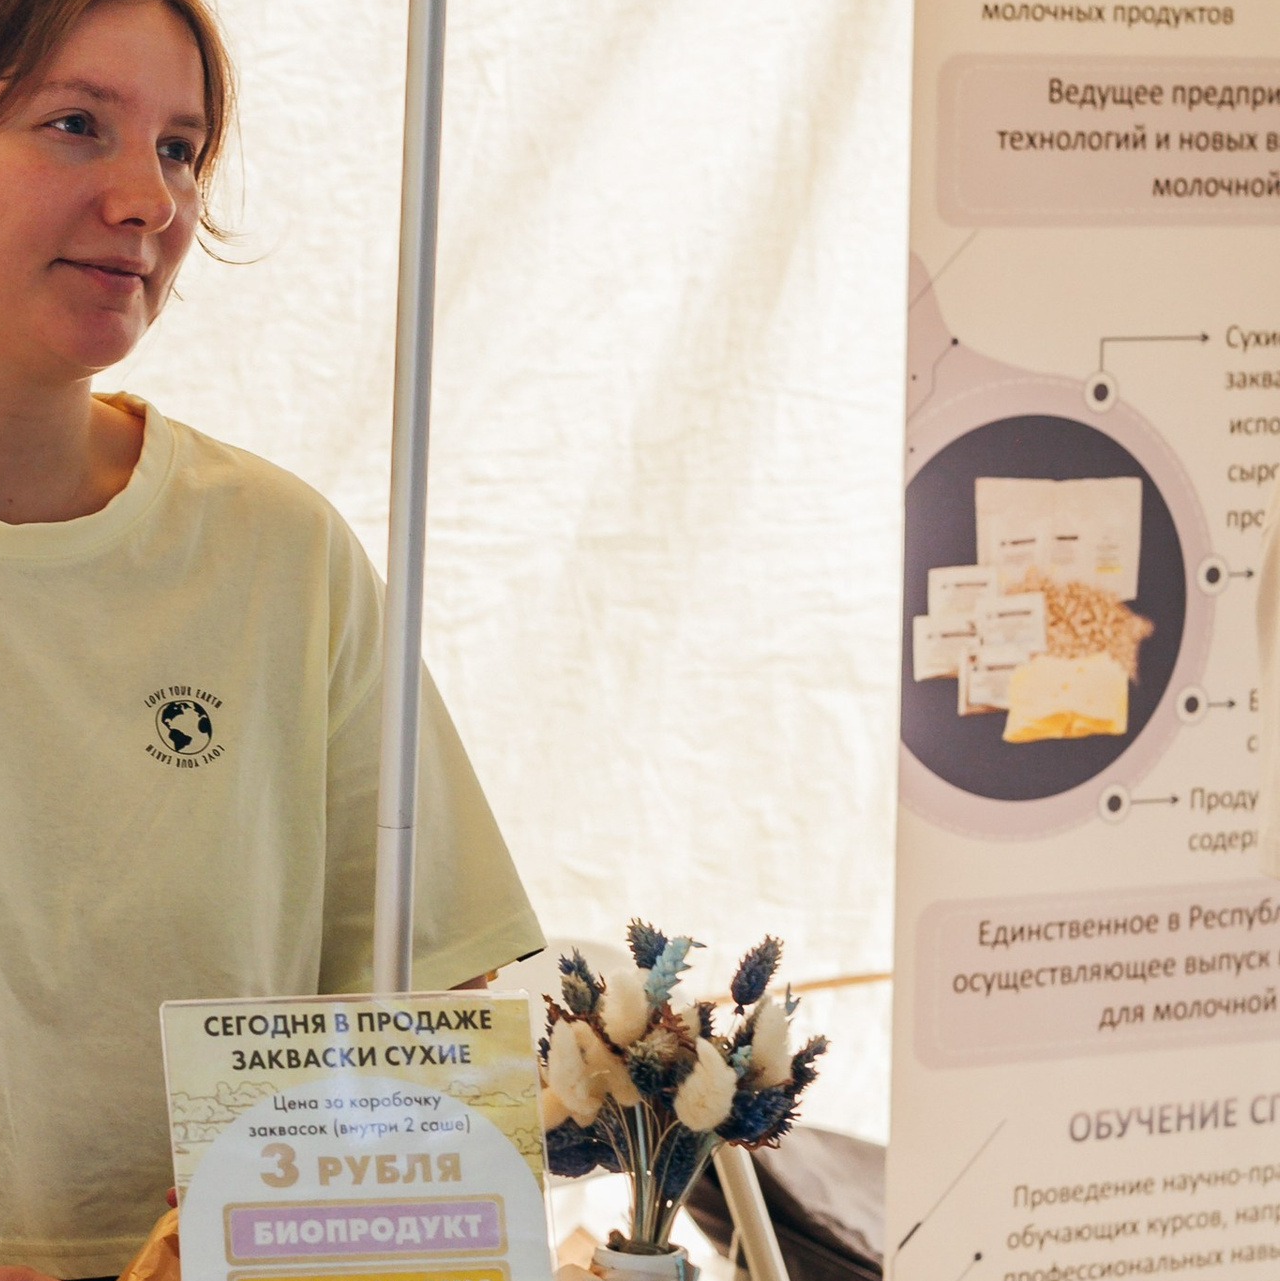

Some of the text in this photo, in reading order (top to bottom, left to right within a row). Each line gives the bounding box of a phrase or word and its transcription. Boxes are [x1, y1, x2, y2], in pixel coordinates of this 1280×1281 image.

[981, 2, 1235, 29] молочных продуктов
[1048, 77, 1164, 111] Ведущее
[997, 124, 1259, 153] технологий и новых
[144, 688, 167, 709] LOVE
[1187, 829, 1259, 856] содер
[978, 914, 1160, 951] Единственное
[1167, 912, 1181, 933] в
[952, 949, 1271, 997] осуществляющее выпуск
[204, 1009, 493, 1039] СЕГОДНЯ В ПРОДАЖЕ
[1098, 985, 1278, 1031] для молочной
[231, 1044, 472, 1071] ЗАКВАСКИ СУХИЕ
[273, 1090, 442, 1113] Цена за коробочку
[248, 1114, 471, 1139] заквасок (внутри 2 саше)
[1069, 1097, 1239, 1143] ОБУЧЕНИЕ
[259, 1142, 463, 1189] 3 РУБЛЯ
[1013, 1176, 1156, 1211] Проведение
[253, 1213, 483, 1248] БИОПРОДУКТ
[1006, 1209, 1228, 1251] обучающих курсов,
